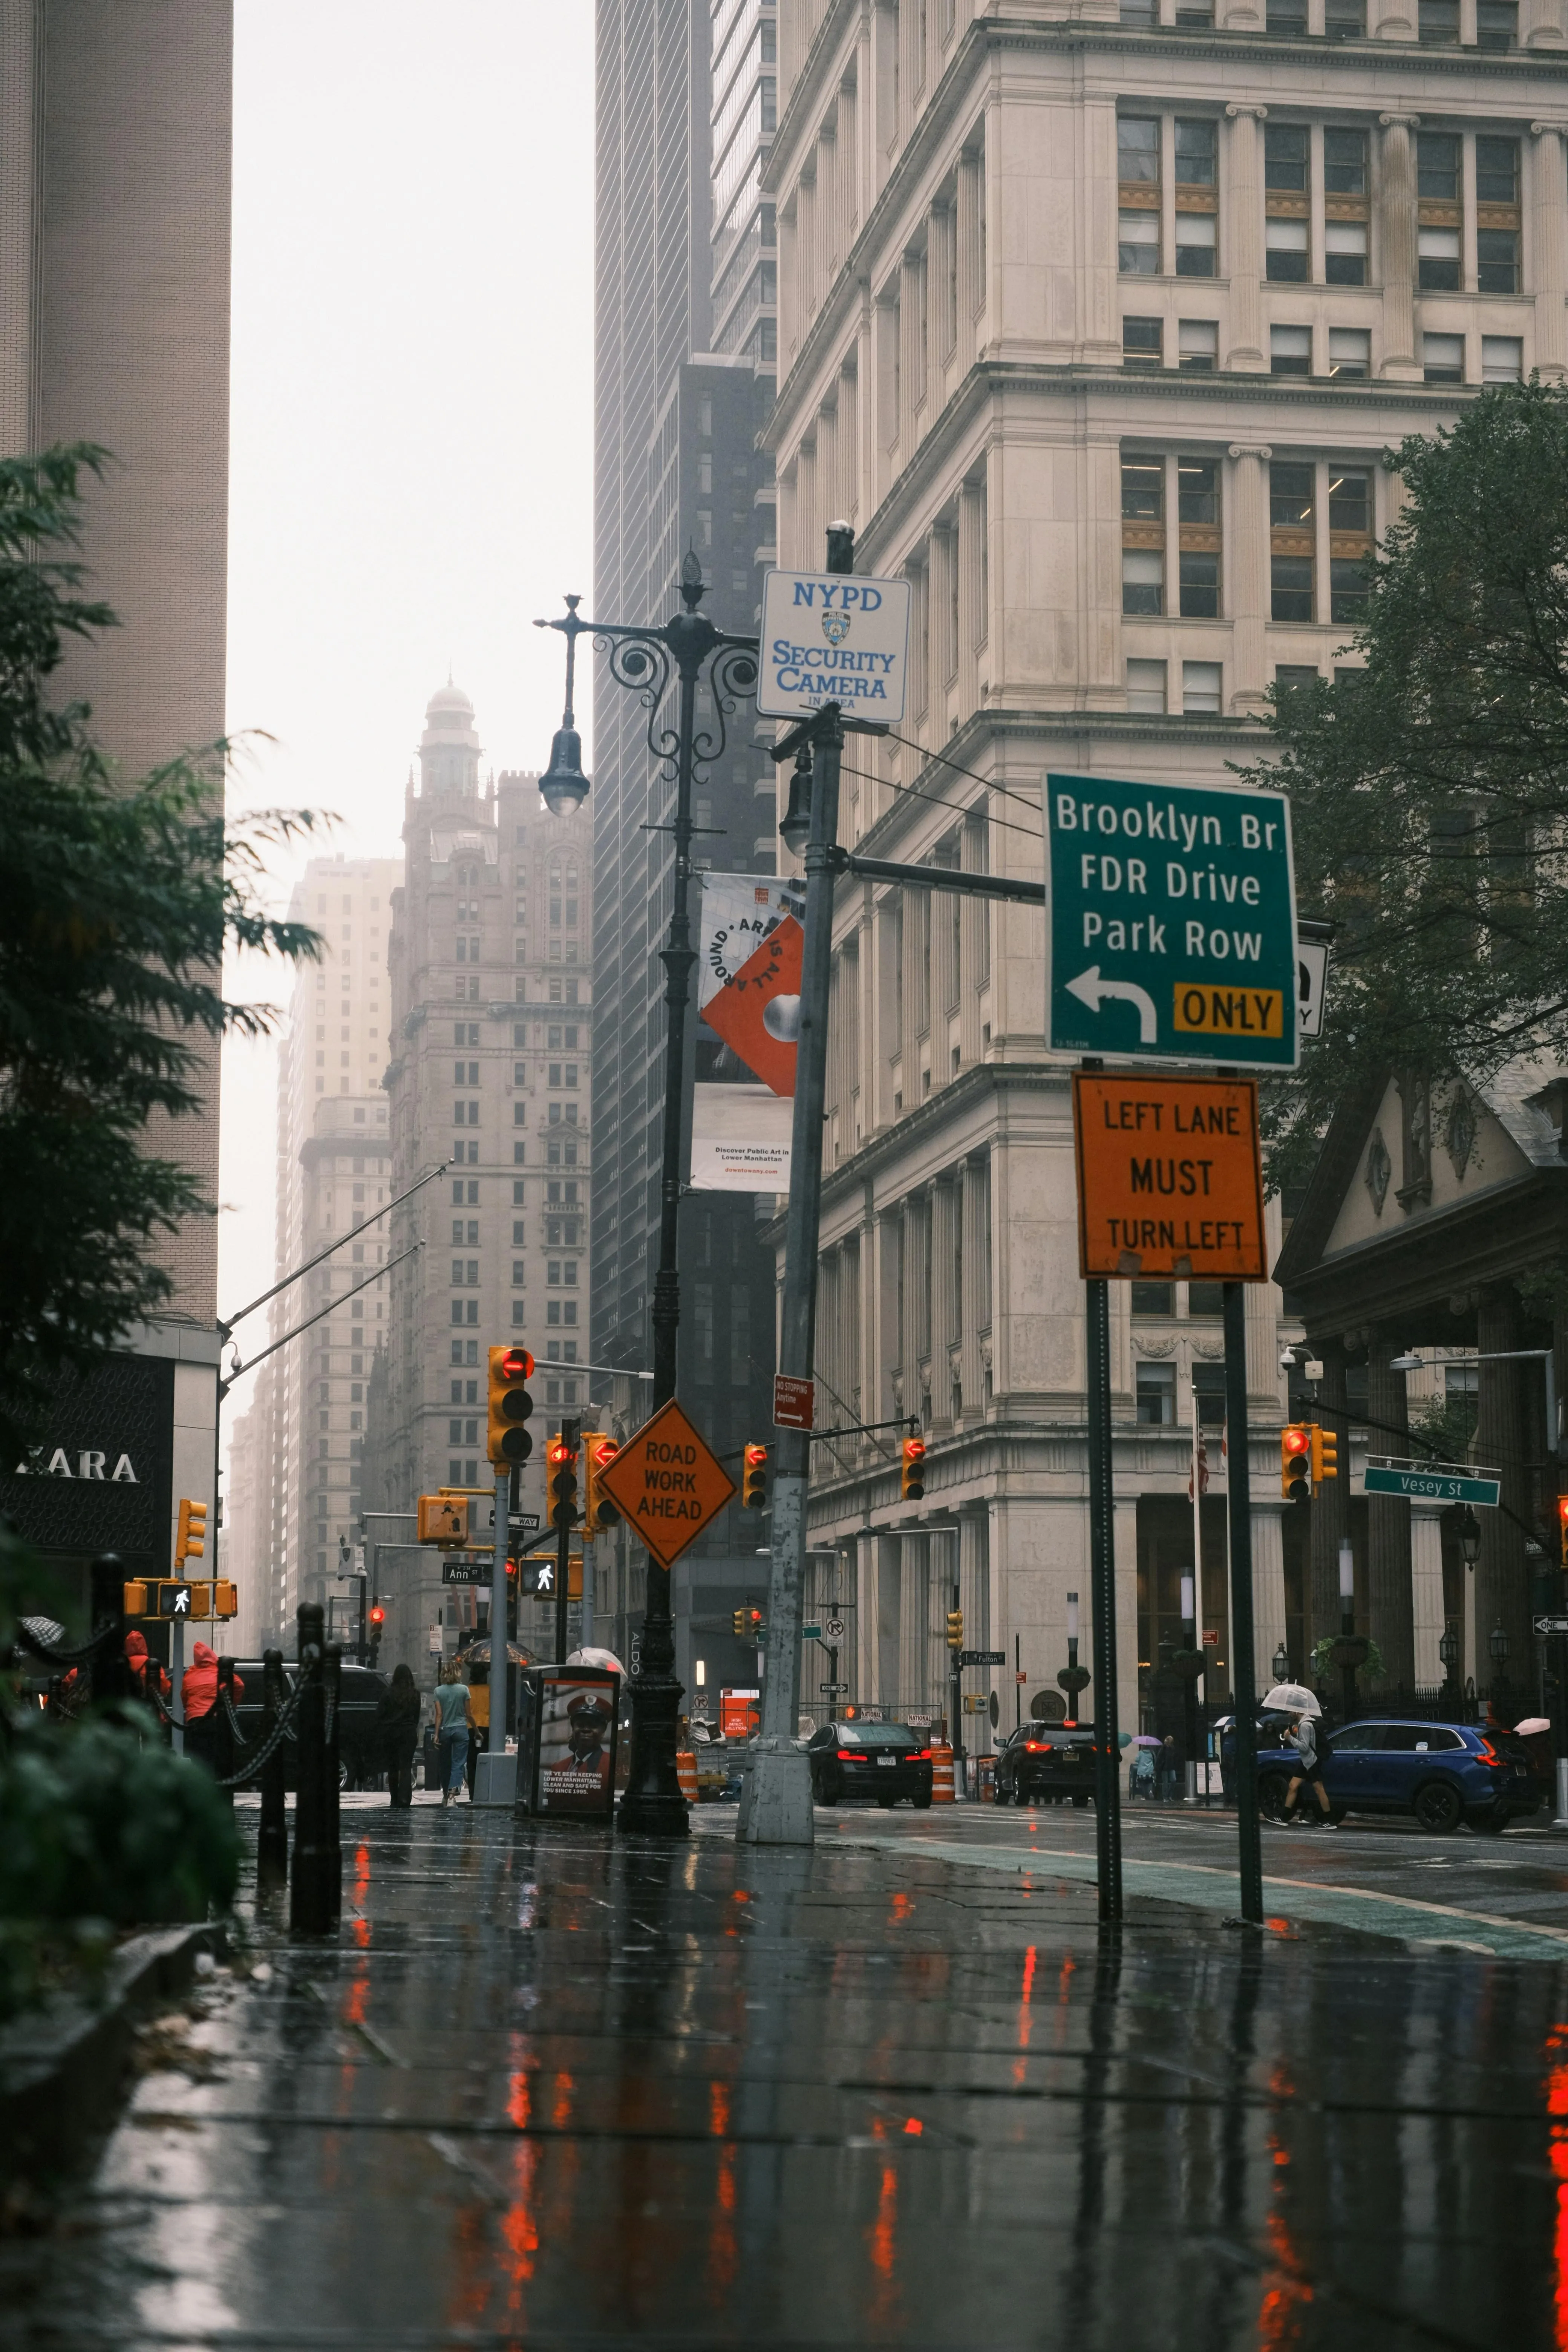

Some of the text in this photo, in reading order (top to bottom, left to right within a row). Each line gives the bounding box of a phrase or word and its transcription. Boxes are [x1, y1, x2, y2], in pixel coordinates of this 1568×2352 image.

[793, 582, 882, 611] NYPD
[772, 640, 896, 673] SECURITY
[776, 667, 887, 699] CAMERA
[808, 697, 821, 706] IN
[1057, 794, 1277, 853] Brooklyn Br
[1081, 854, 1260, 905] FDR Drive
[740, 918, 774, 938] ART
[1083, 912, 1262, 961] Park Row
[769, 939, 783, 957] IS
[752, 961, 780, 989] ALL
[1182, 989, 1273, 1031] ONLY
[1104, 1100, 1240, 1135] LEFT LANE
[1131, 1158, 1213, 1196] MUST
[1107, 1219, 1244, 1251] TURN LEFT
[777, 1381, 808, 1394] NO STOPPING
[777, 1392, 796, 1404] Anytime
[646, 1441, 696, 1465] ROAD
[645, 1470, 697, 1493] WORK
[1401, 1477, 1462, 1497] Vesey St
[519, 1517, 535, 1526] WAY
[636, 1496, 702, 1520] AHEAD
[450, 1569, 468, 1579] Ann
[631, 1631, 640, 1674] ALDO
